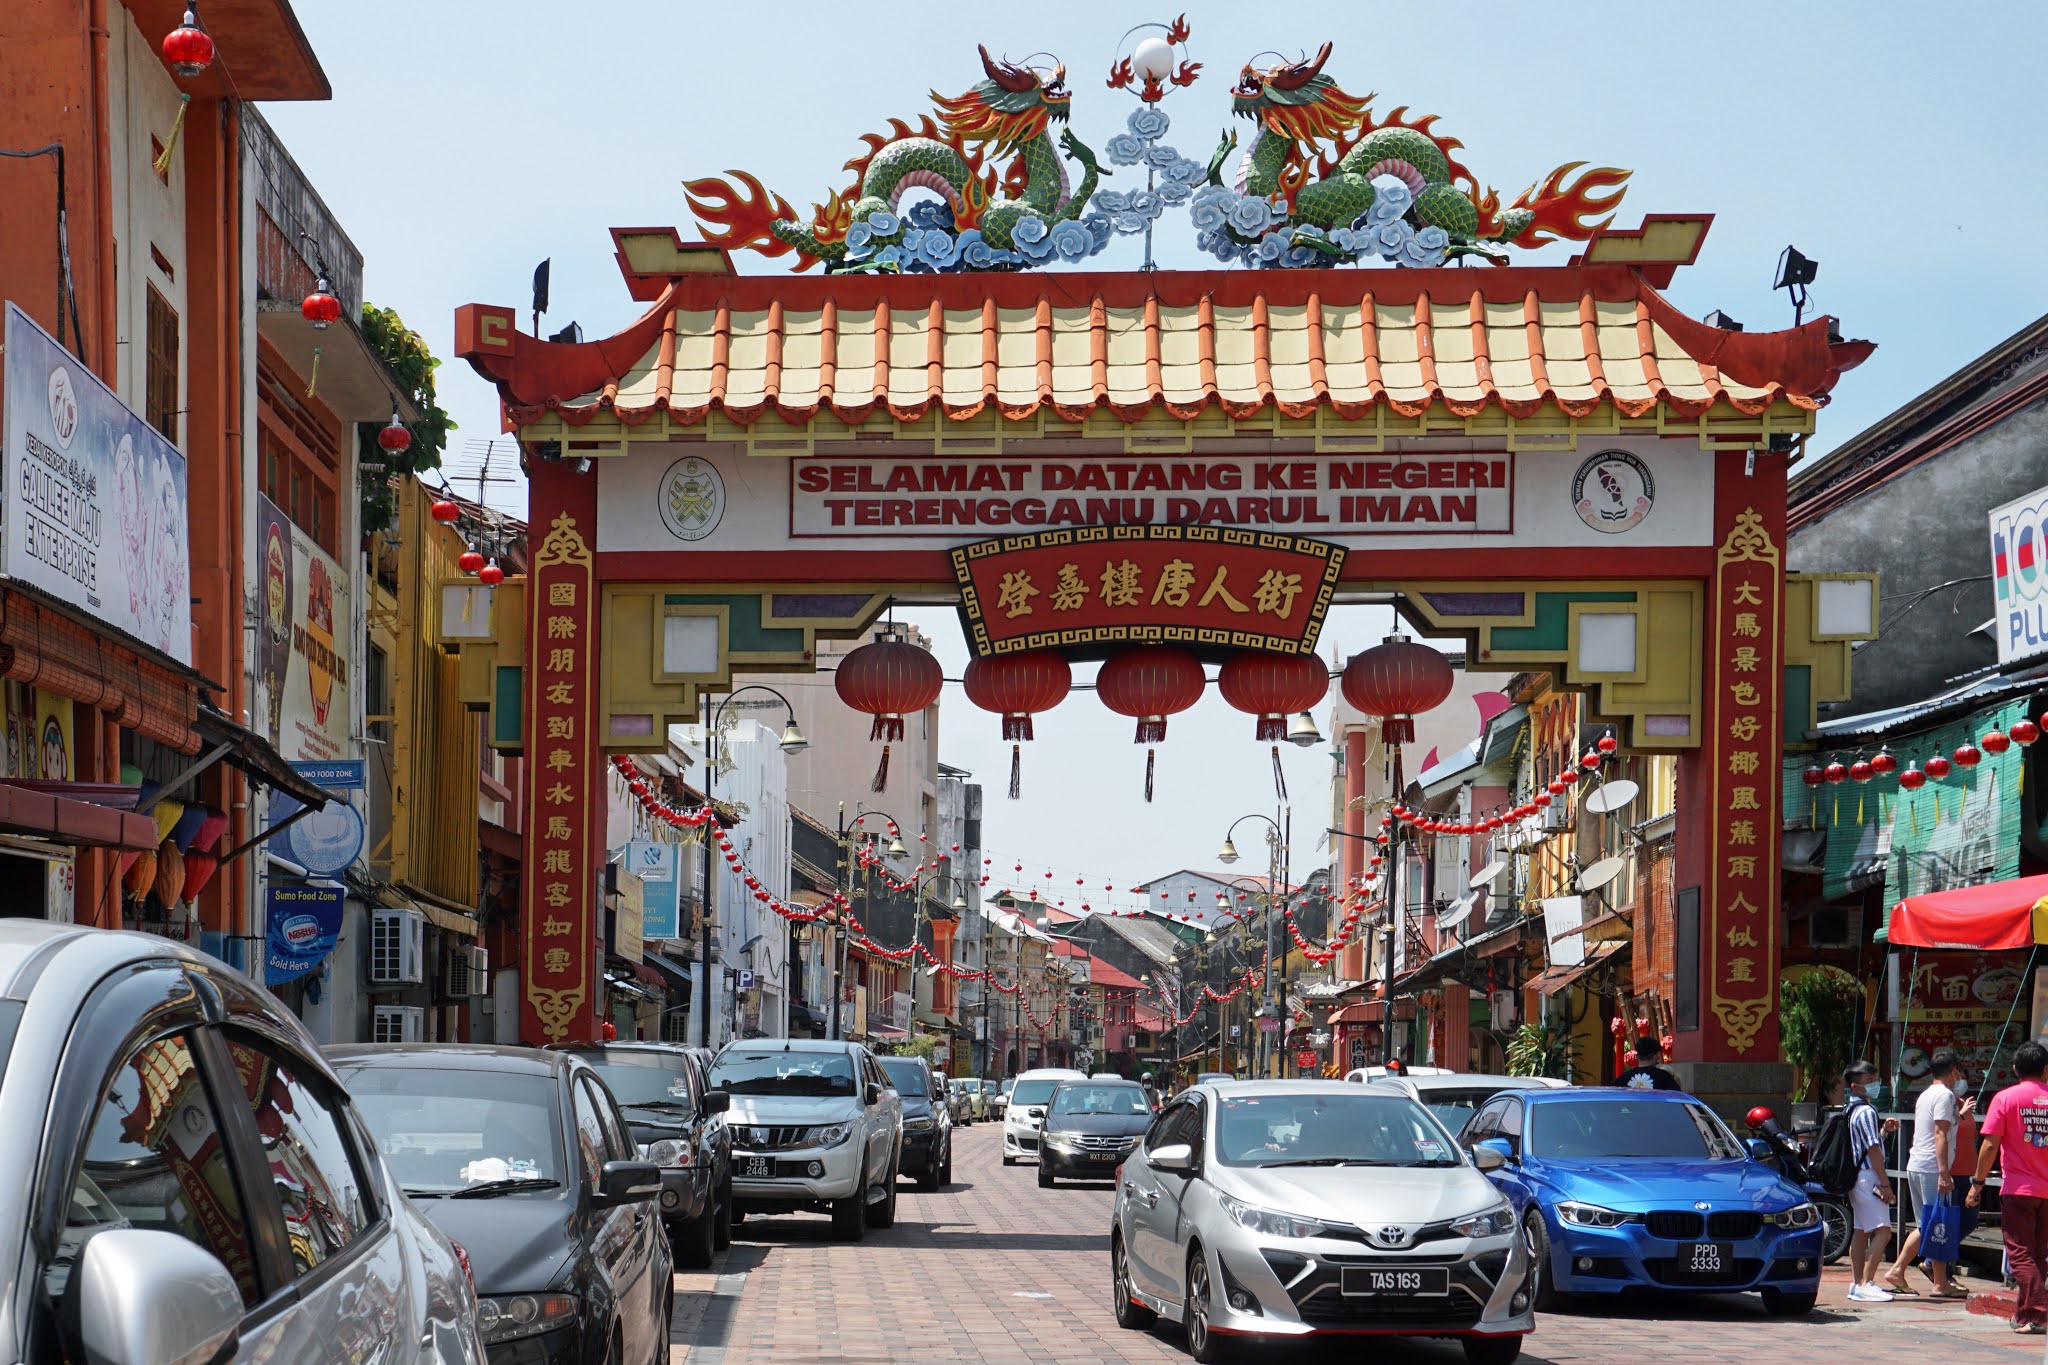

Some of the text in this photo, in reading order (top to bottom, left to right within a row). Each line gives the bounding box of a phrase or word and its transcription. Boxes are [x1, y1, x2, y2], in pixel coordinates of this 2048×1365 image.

[798, 461, 1506, 492] SELAMAT DATANG KE NEGERI
[20, 457, 101, 548] GALILEE MAJU
[824, 495, 1477, 526] TERENGGANU DARUL IMAN
[25, 511, 96, 592] ENTERPRISE
[997, 558, 1303, 620] 登嘉樓唐人街
[317, 770, 334, 778] FOOD
[543, 583, 577, 973] 國際朋友到車水馬龍客如雲
[1726, 580, 1763, 983] 大馬景色好椰風蕉雨人似畫
[275, 890, 337, 901] Sumo Food Zone
[270, 955, 309, 971] Sold Here
[739, 971, 753, 987] P
[749, 1157, 766, 1167] CEB
[746, 1166, 769, 1175] 2446
[1695, 1244, 1717, 1257] PPD
[1690, 1257, 1721, 1270] 3333
[1370, 1272, 1421, 1289] TAS 163
